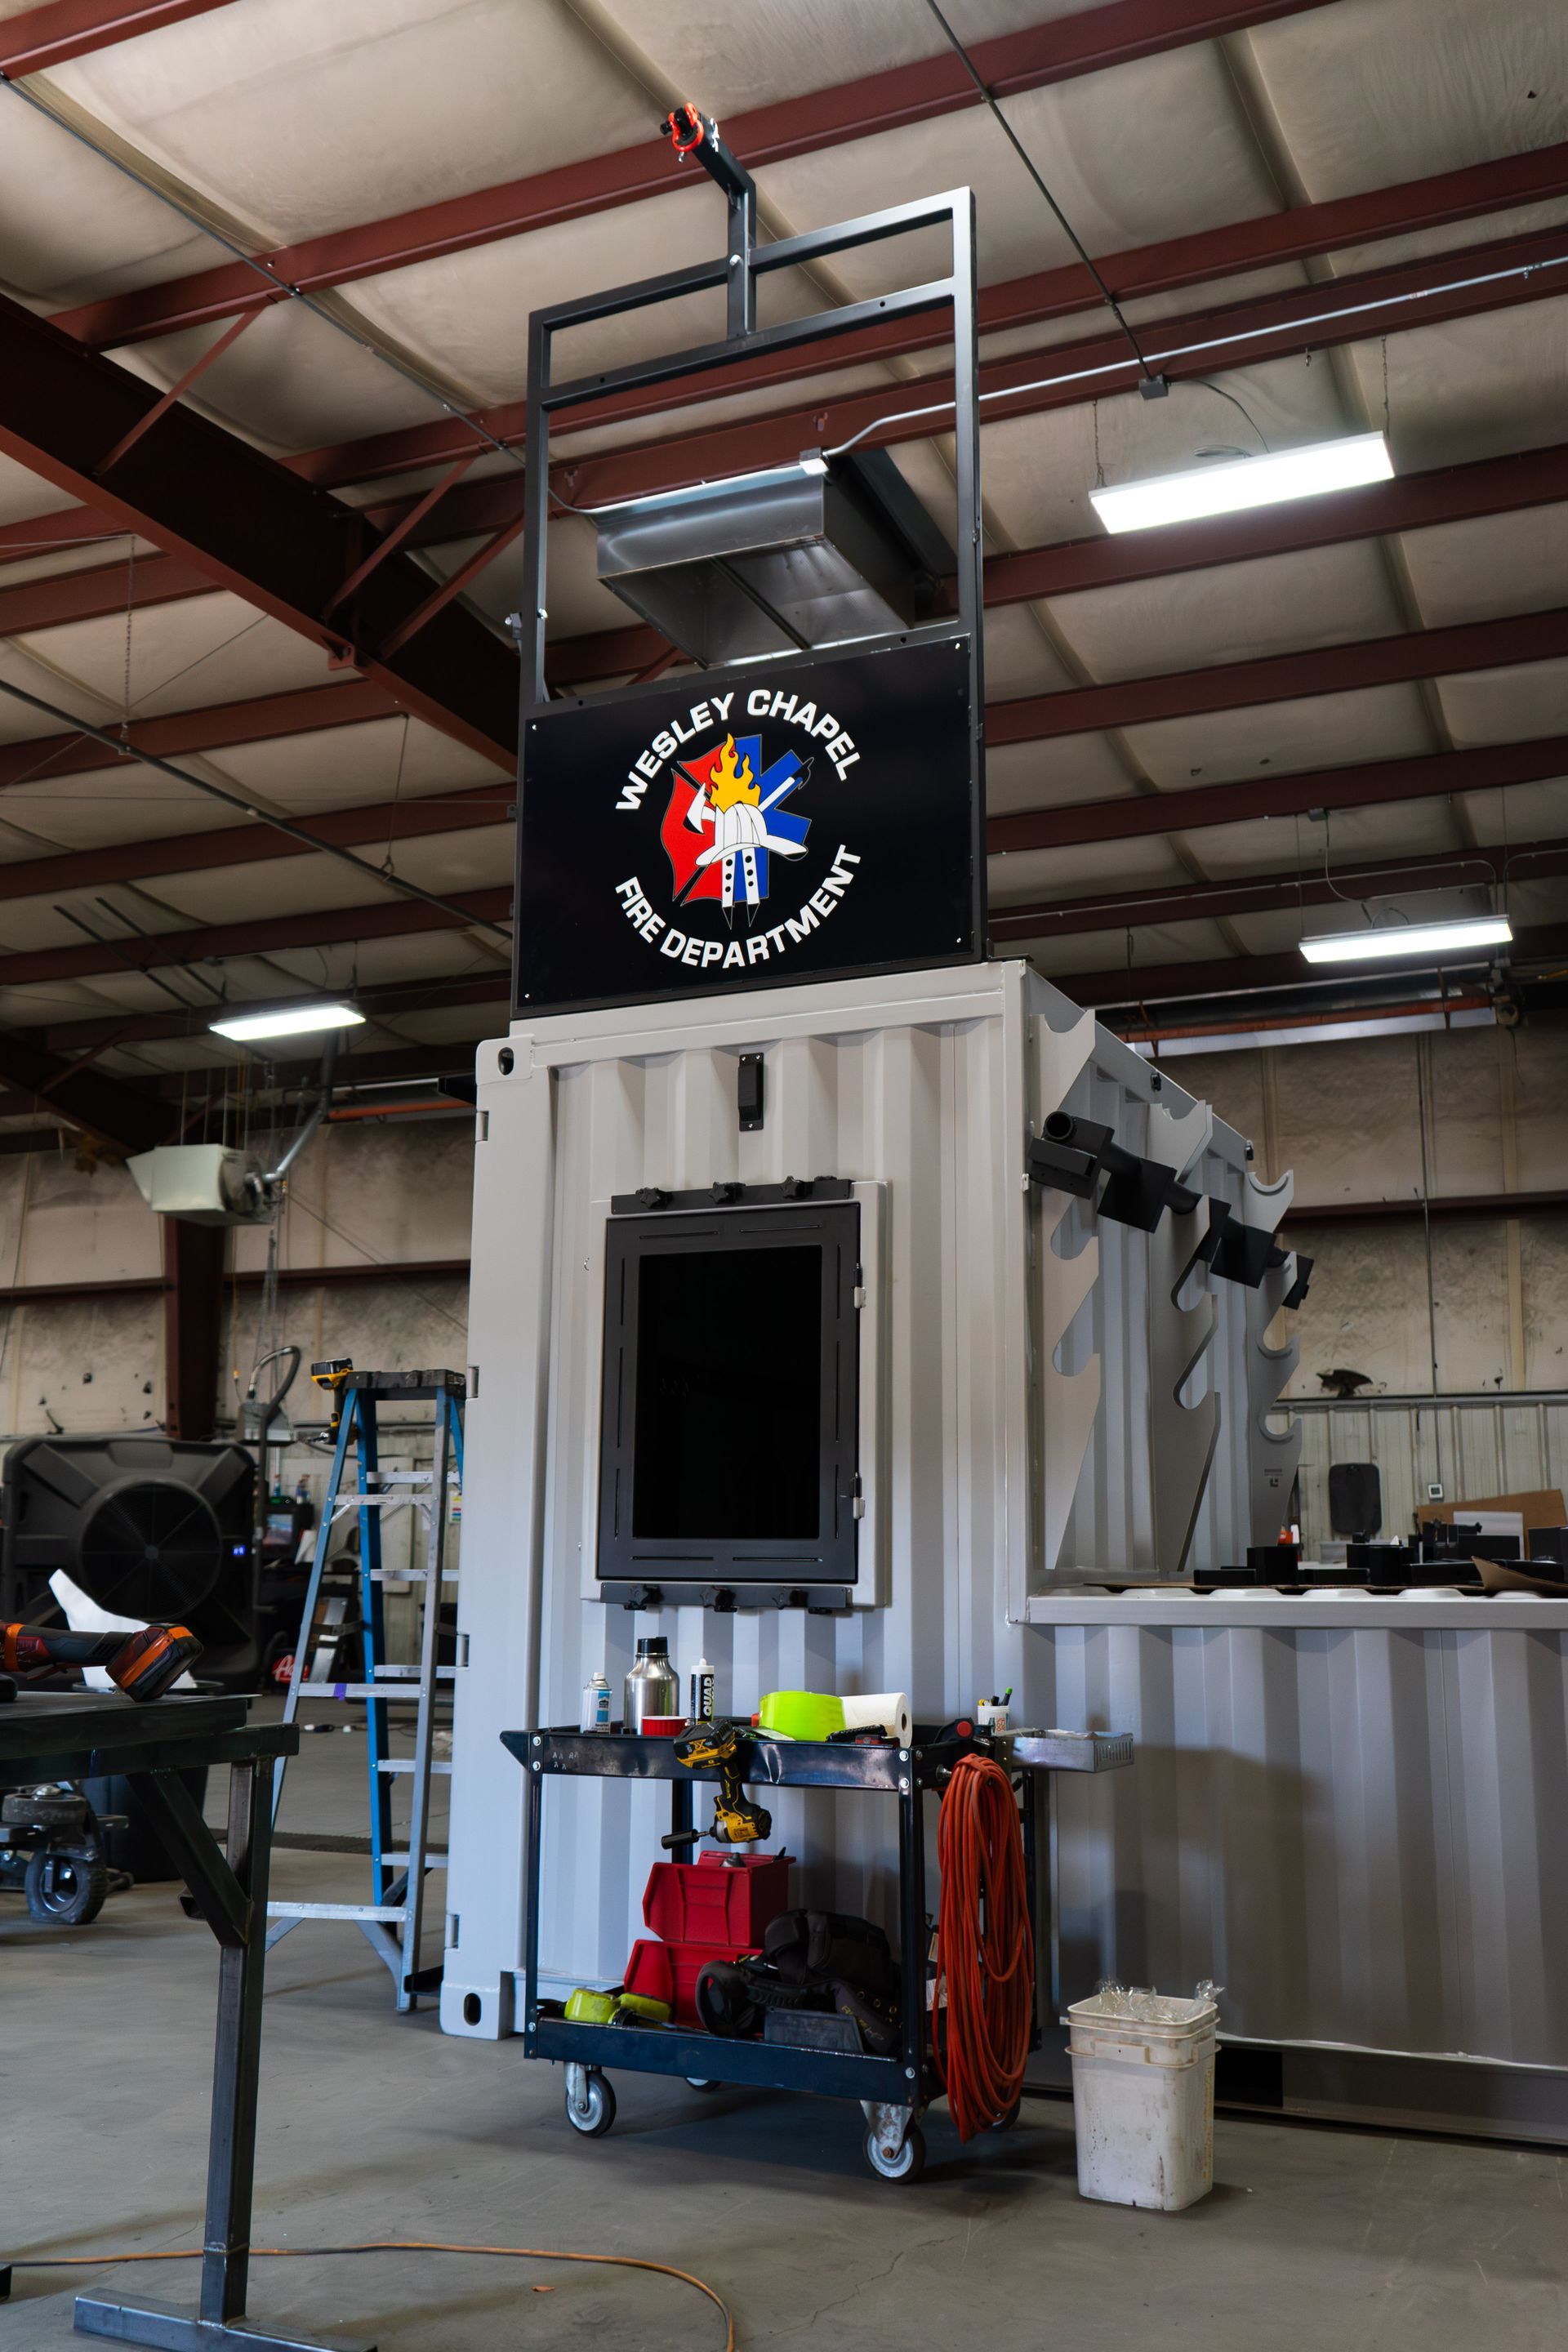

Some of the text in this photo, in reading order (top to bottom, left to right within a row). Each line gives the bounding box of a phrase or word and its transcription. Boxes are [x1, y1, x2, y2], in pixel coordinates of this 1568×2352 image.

[615, 689, 861, 810] WESLEY CHAPEL
[615, 844, 862, 969] FIRE DEPARTMENT
[703, 1677, 714, 1717] QUAD
